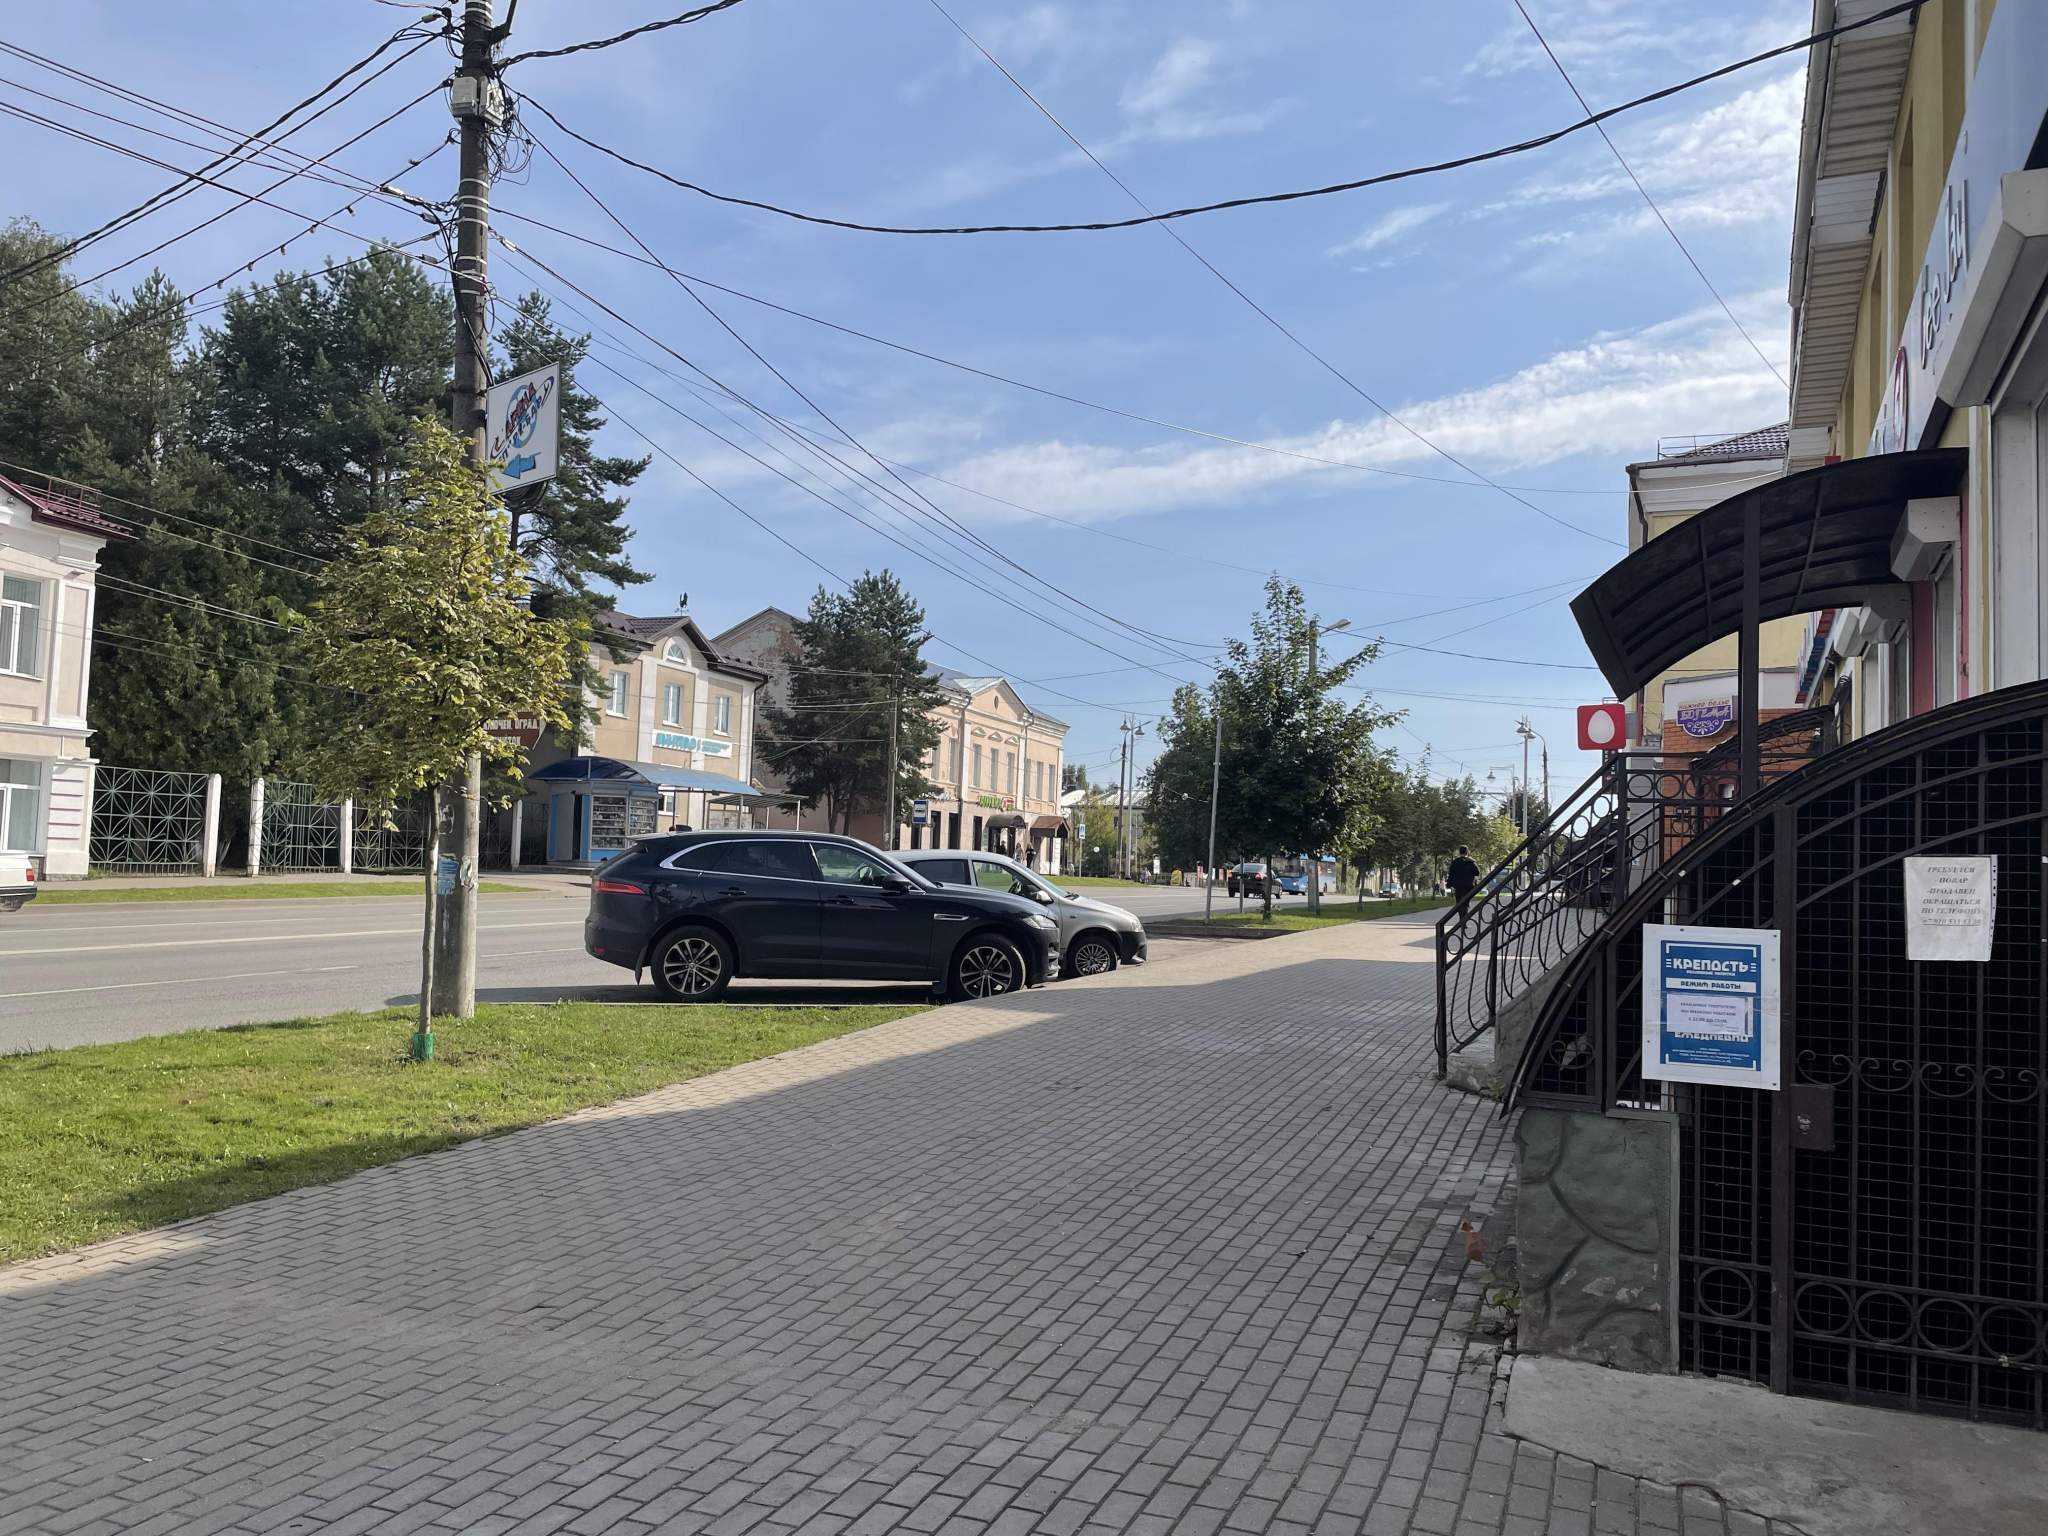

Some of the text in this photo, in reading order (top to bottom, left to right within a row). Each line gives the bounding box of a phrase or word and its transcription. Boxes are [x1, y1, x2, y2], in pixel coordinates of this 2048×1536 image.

[1673, 958, 1749, 972] КРЕПОСТЬ
[1680, 980, 1741, 990] РЕЖИМ РАБОТЫ
